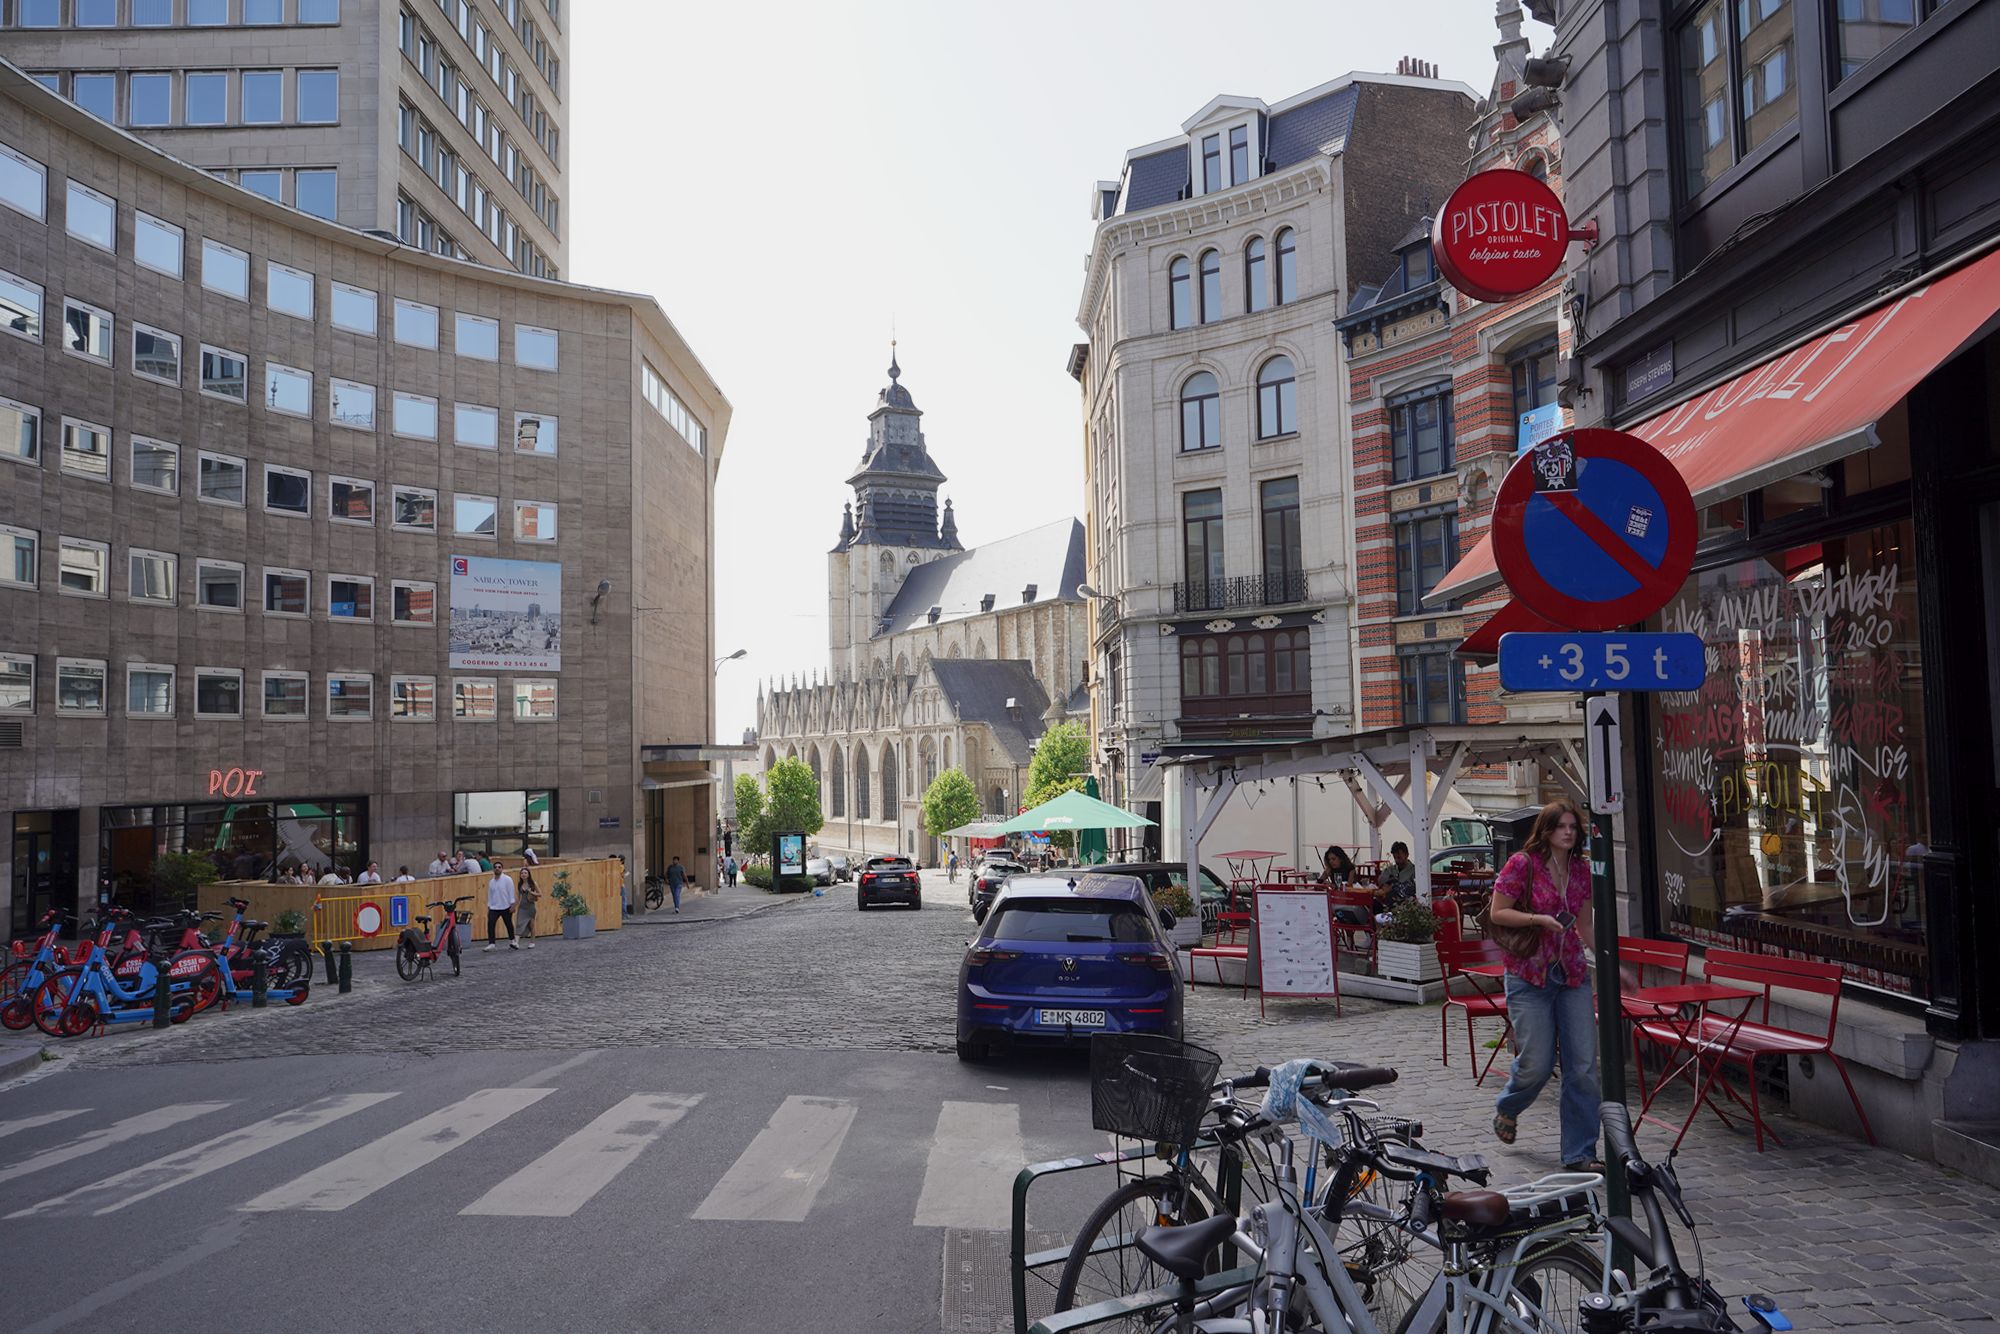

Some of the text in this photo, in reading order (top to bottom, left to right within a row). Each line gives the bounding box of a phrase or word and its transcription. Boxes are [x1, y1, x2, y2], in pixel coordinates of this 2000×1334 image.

[1451, 199, 1561, 245] PISTOLET
[1487, 235, 1523, 243] ORIGINAL
[1469, 247, 1541, 264] belgian taste
[1628, 360, 1671, 392] JOSEPH STEVENS
[1530, 416, 1555, 433] PORTES
[509, 578, 538, 587] TOWER
[1716, 584, 1783, 641] AWAY
[1847, 614, 1894, 651] 2020
[1537, 643, 1669, 688] +3,5 t
[1720, 761, 1826, 832] PISTOLET
[178, 958, 198, 967] ESSAI
[1075, 1012, 1104, 1024] 4802
